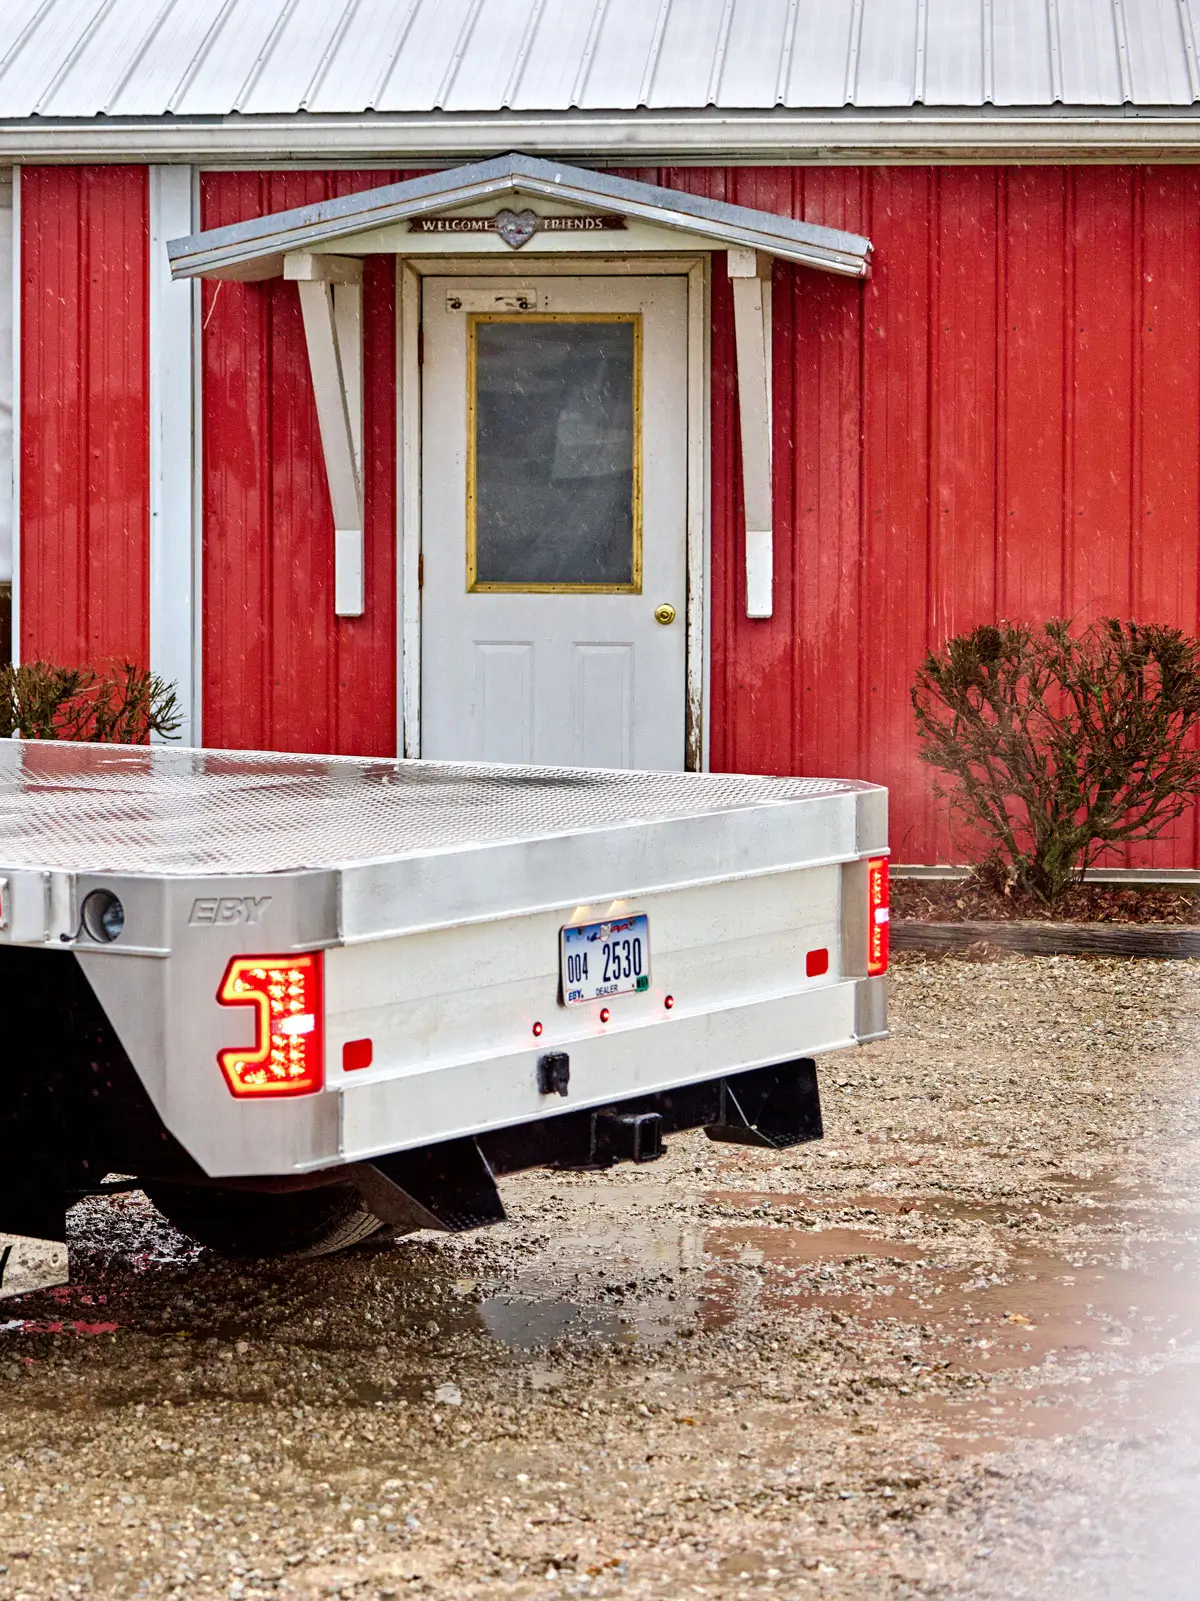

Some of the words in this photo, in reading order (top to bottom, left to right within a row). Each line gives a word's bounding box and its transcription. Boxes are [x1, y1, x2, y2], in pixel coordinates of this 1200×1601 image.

[422, 220, 490, 231] WELCOME
[544, 217, 603, 230] FRIENDS
[187, 896, 272, 926] EBY
[567, 952, 588, 983] 004
[602, 937, 642, 982] 2530
[595, 984, 619, 996] DEALER
